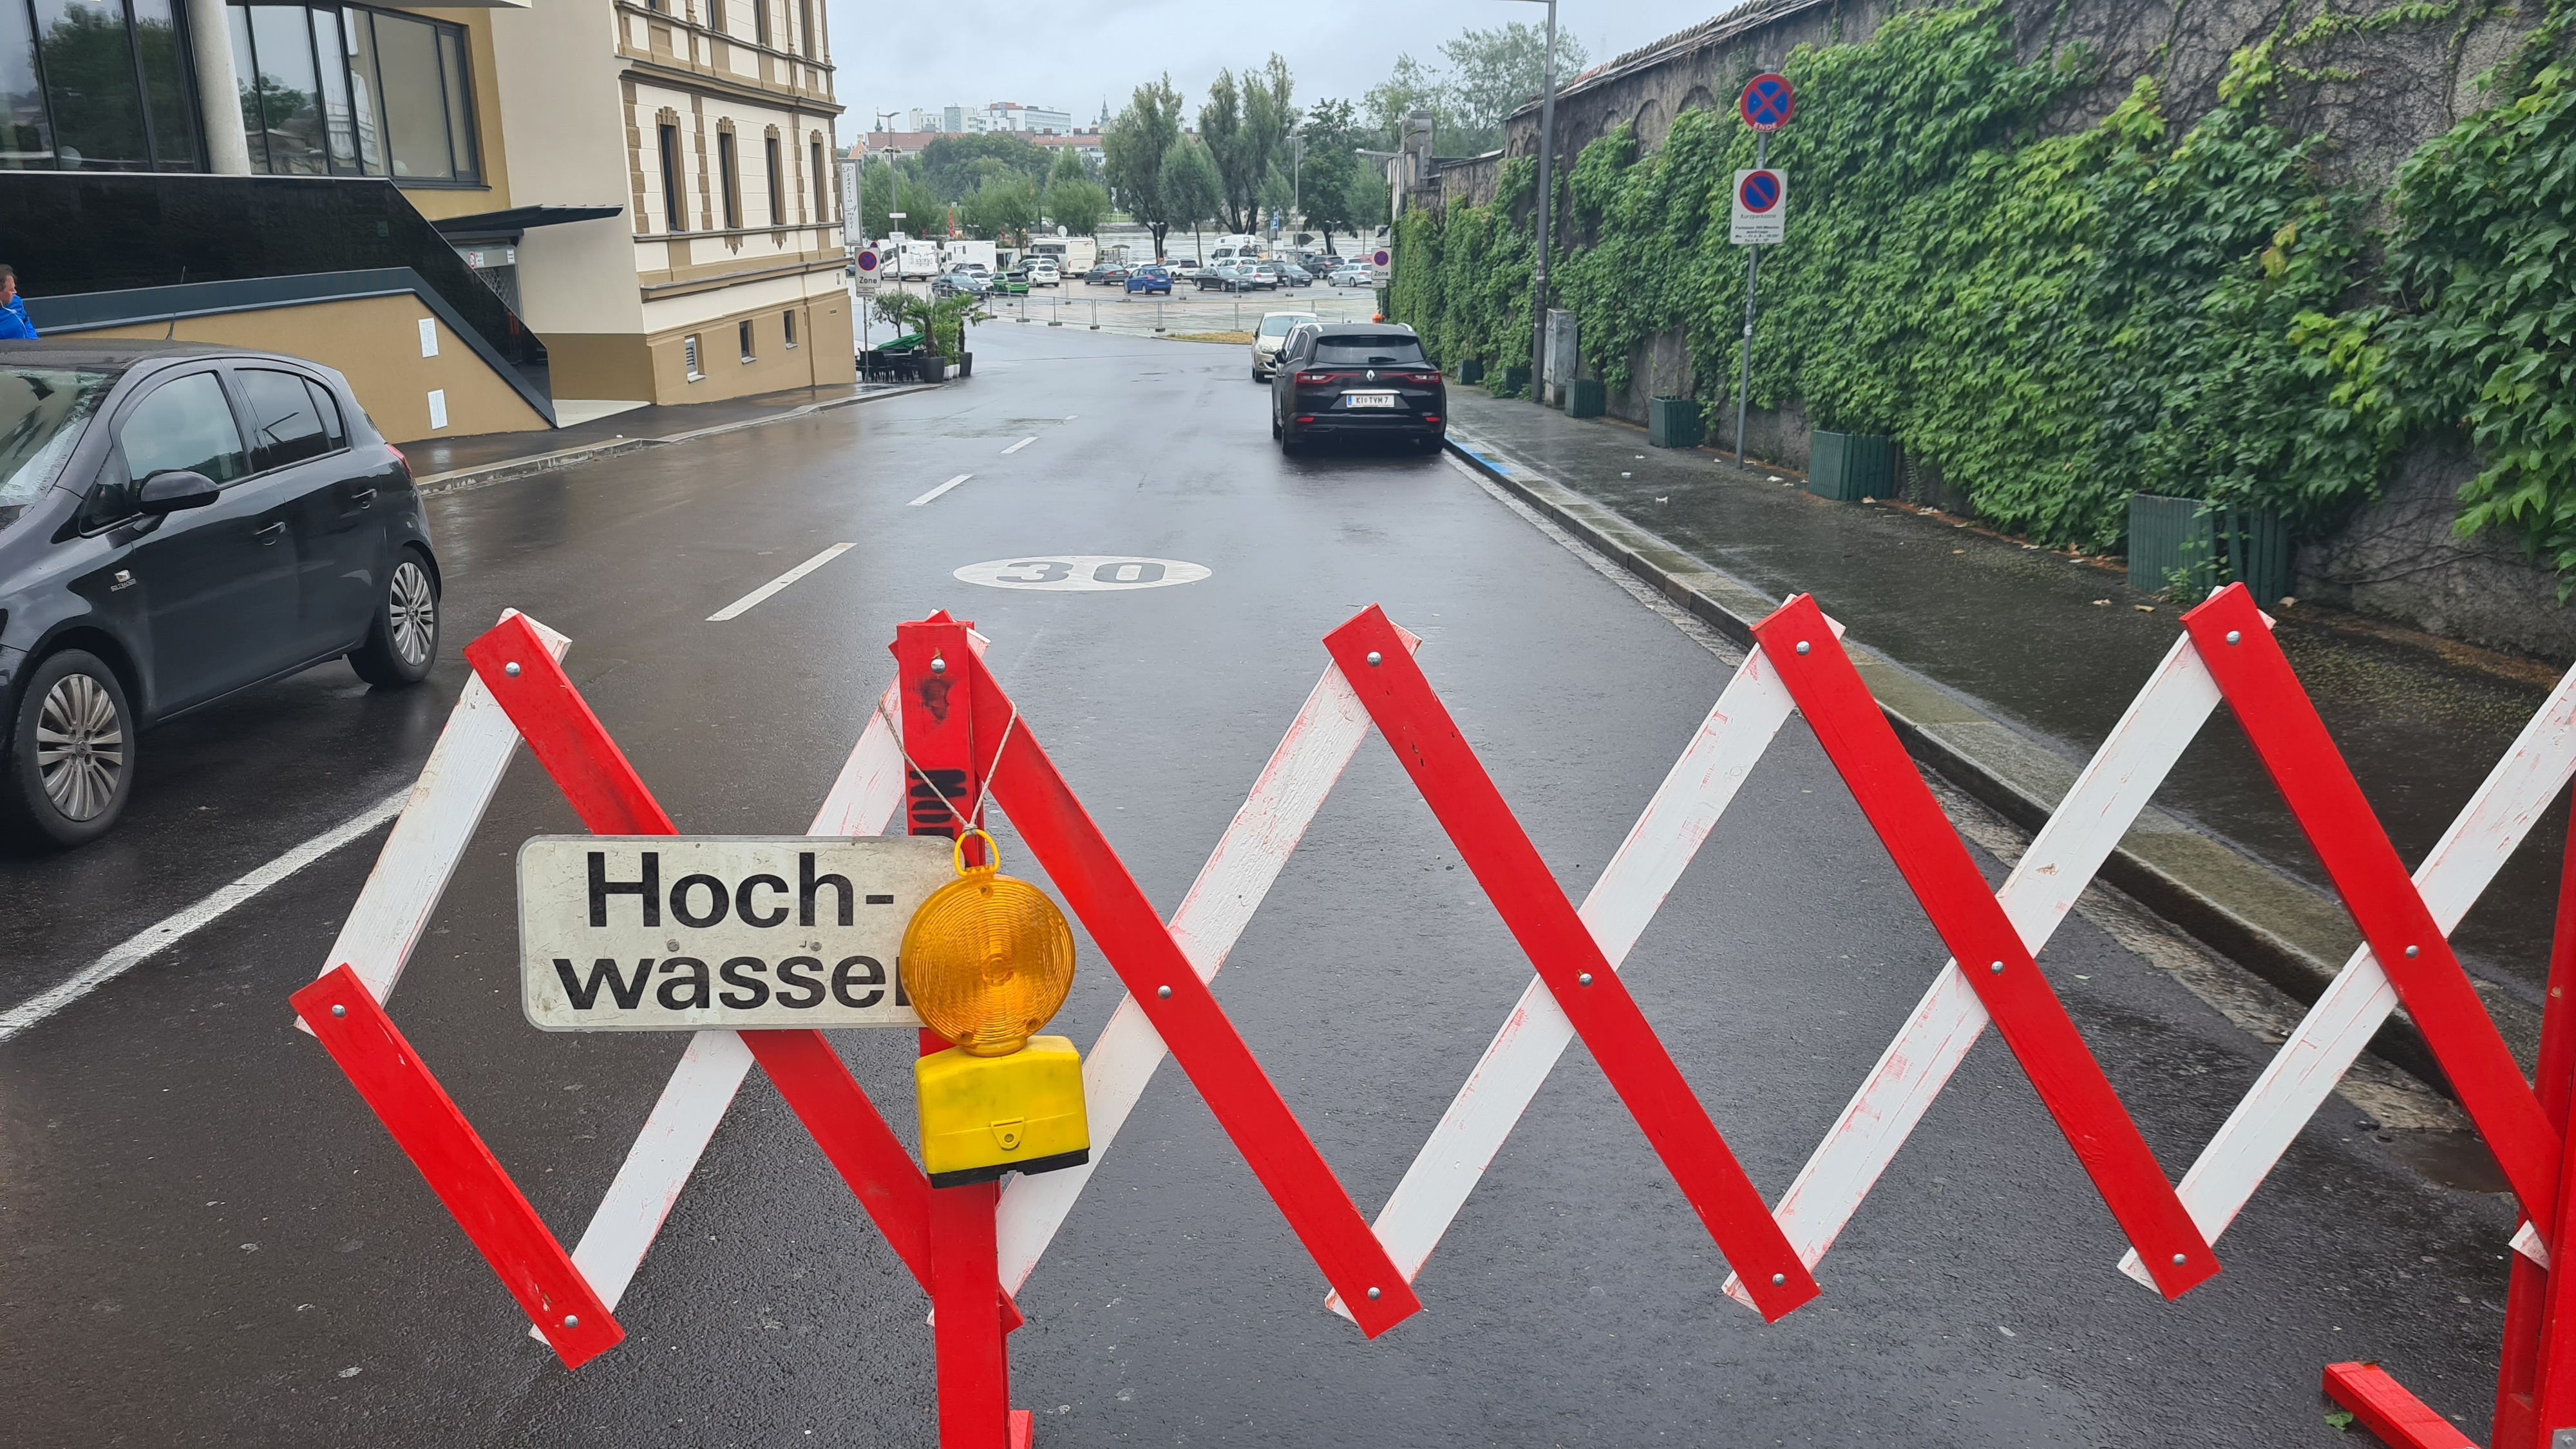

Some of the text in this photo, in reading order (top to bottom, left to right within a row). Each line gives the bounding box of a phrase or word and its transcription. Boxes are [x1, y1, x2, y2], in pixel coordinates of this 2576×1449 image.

[1753, 122, 1778, 130] ENDE
[995, 561, 1167, 583] 30
[587, 851, 895, 929] Hoch-
